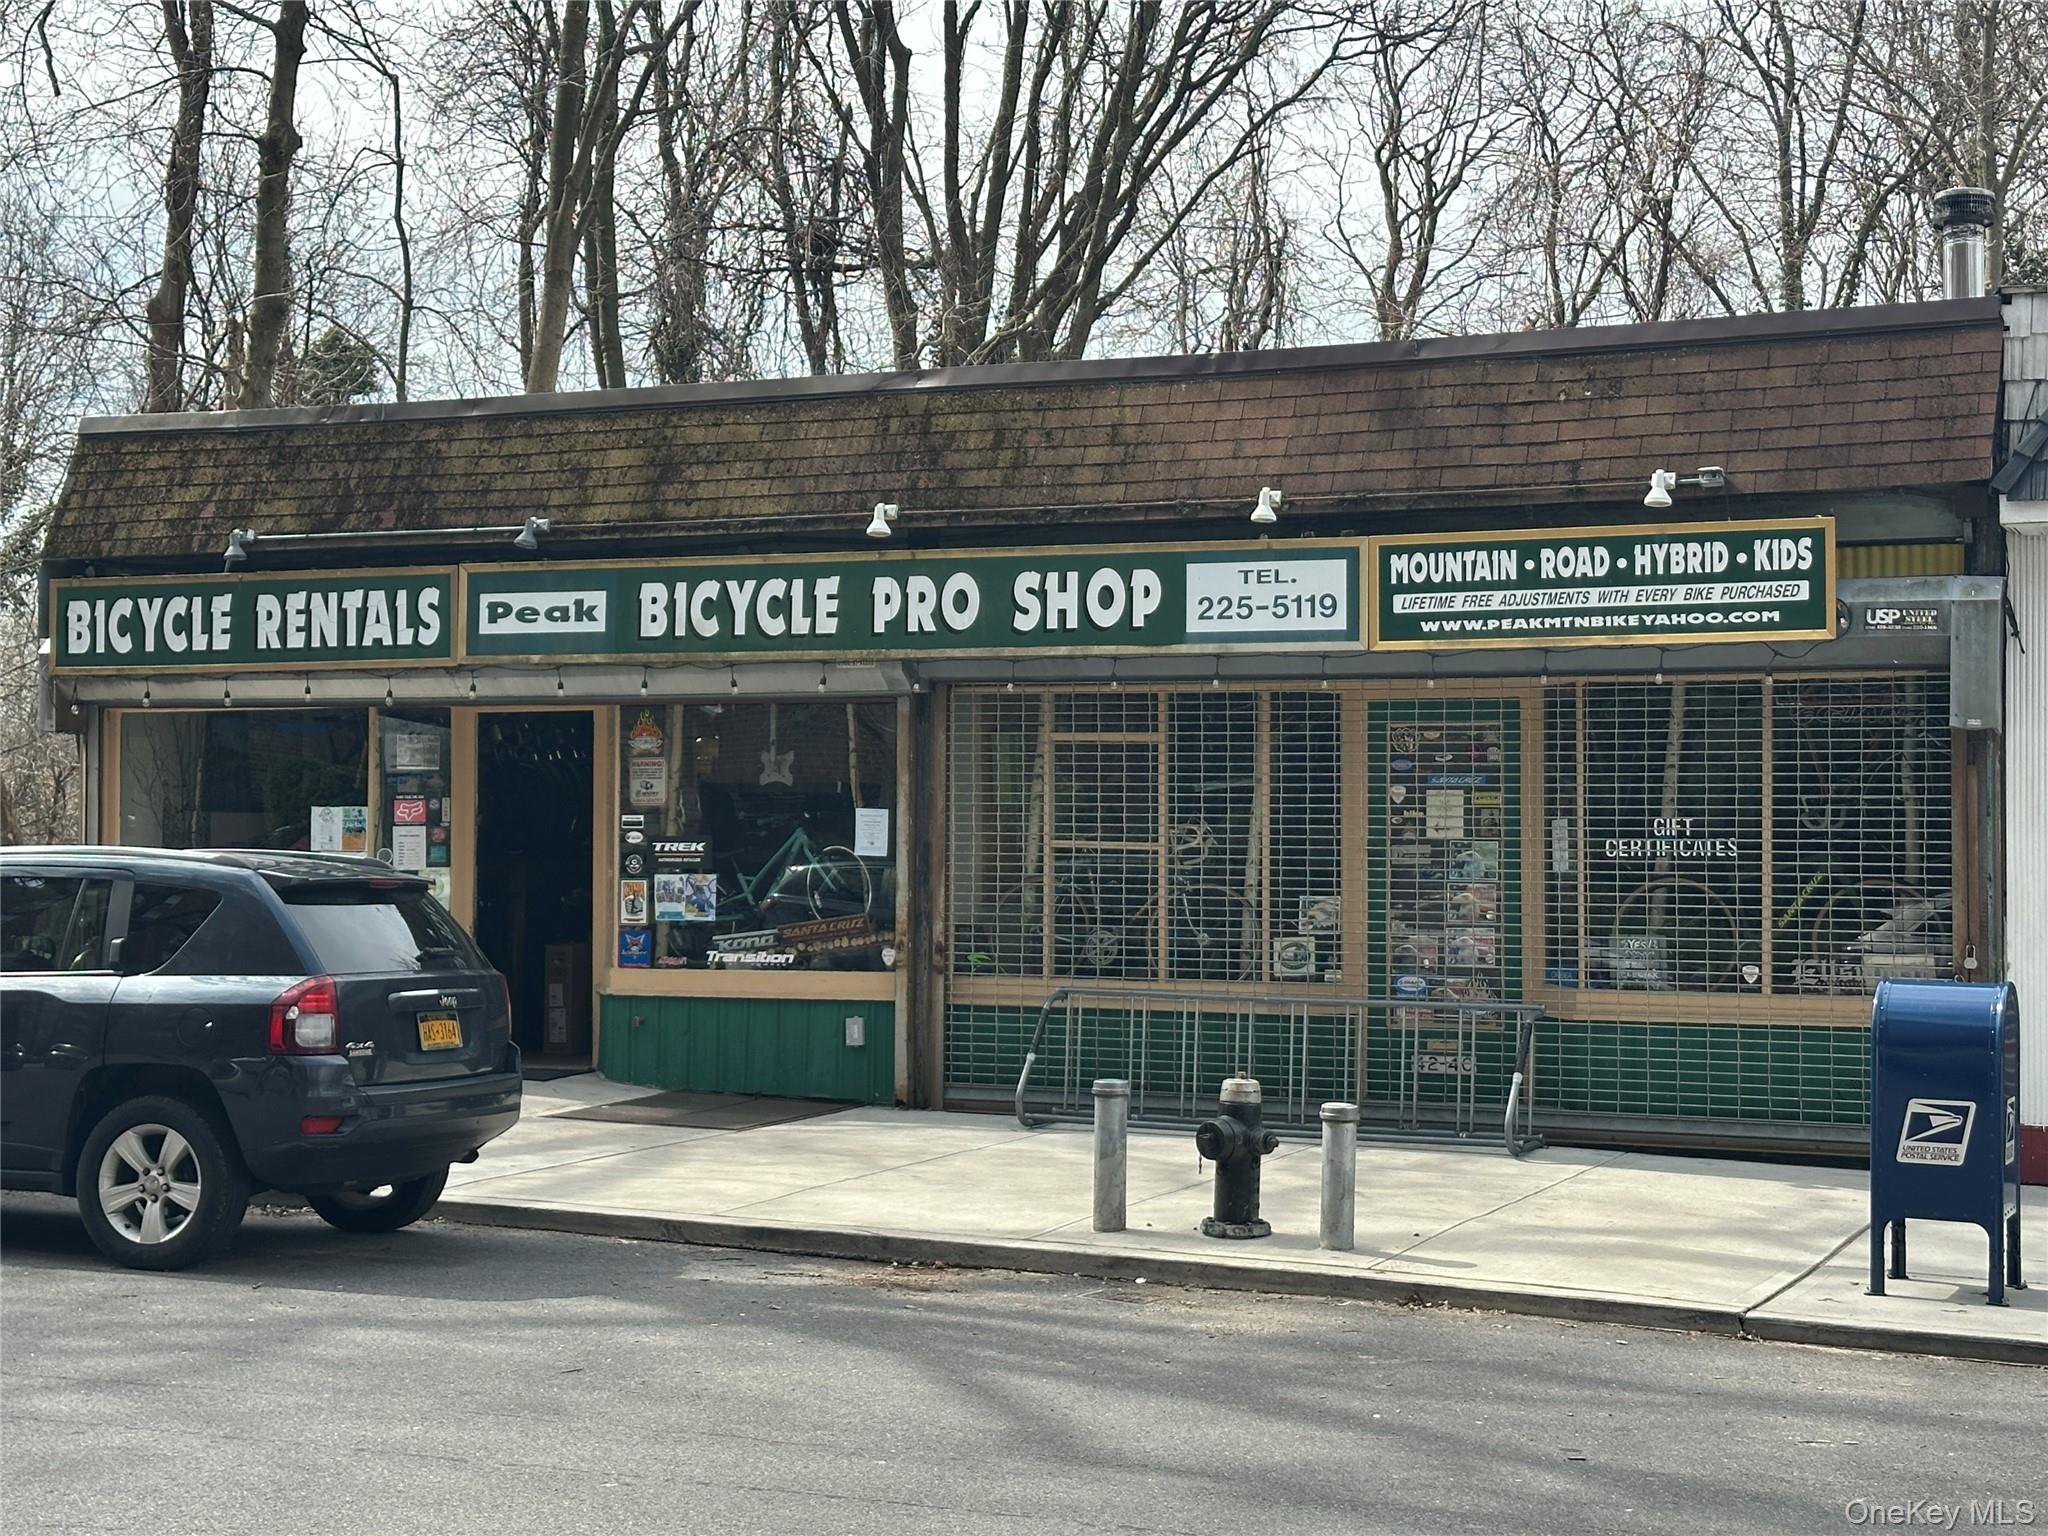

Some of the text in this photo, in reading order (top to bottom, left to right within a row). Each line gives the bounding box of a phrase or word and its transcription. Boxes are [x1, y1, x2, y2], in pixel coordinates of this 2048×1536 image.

[1389, 537, 1813, 584] MOUNTAIN ROAD HYBRID KIDS
[1237, 568, 1298, 585] TEL.
[639, 567, 1163, 638] BICYCLE PRO SHOP
[1197, 593, 1338, 621] 225-5119
[1401, 583, 1801, 611] LIFETIME FREE ADJUSTMENTS WITH EVERY BIKE PURCHASED
[67, 586, 441, 655] BICYCLE RENTALS
[486, 598, 599, 625] Peak
[1866, 608, 1901, 625] USP
[1653, 817, 1694, 836] GIFT
[652, 842, 706, 852] TREK
[1605, 837, 1738, 857] CERTIFICATES
[783, 923, 827, 938] SANTA
[828, 917, 866, 931] CRUZ
[706, 950, 795, 964] Transition
[1900, 1152, 1960, 1162] POSTAL SERVICE
[1902, 1144, 1958, 1154] UNITED STATES
